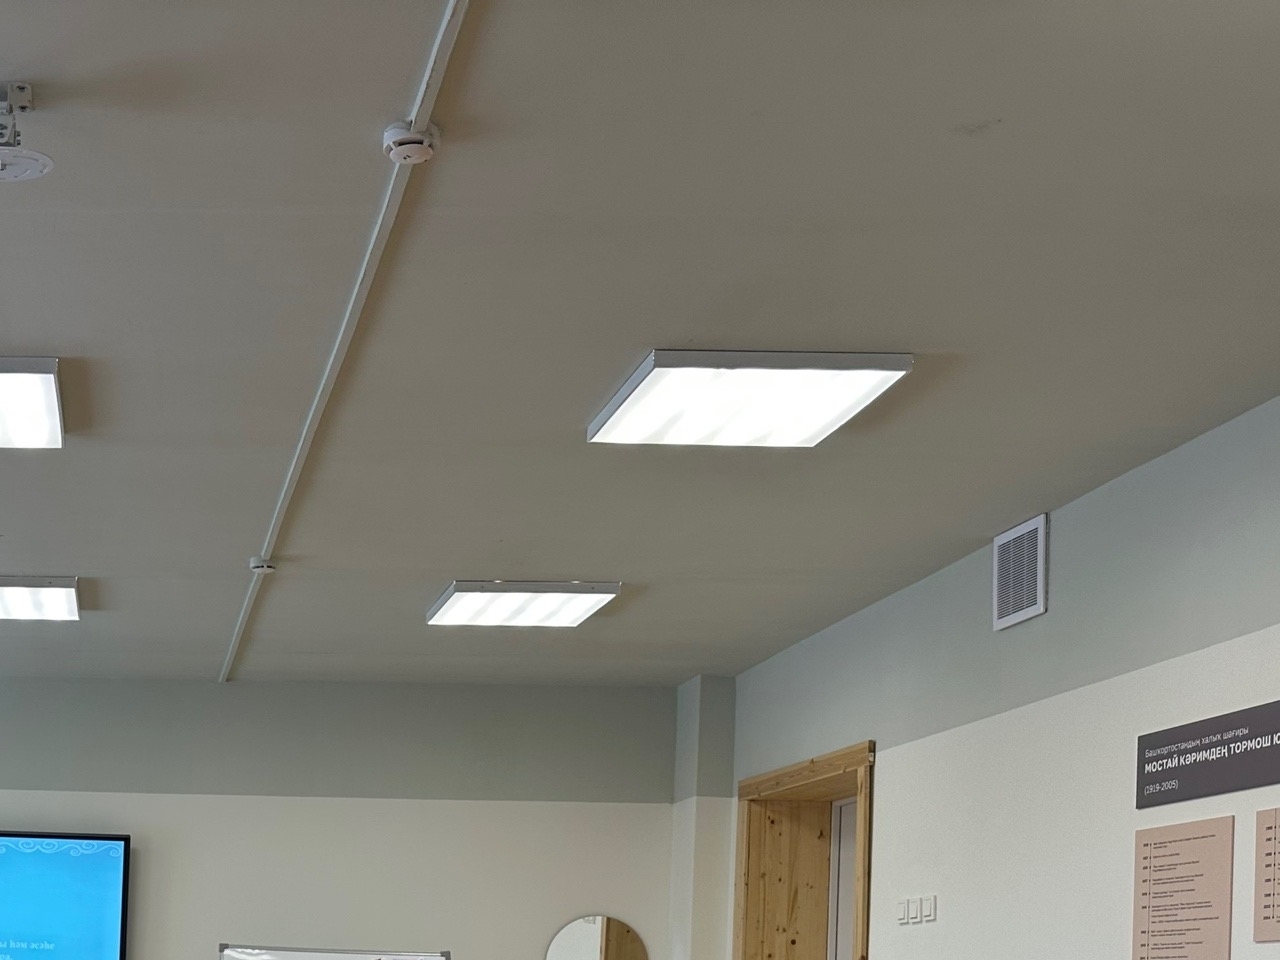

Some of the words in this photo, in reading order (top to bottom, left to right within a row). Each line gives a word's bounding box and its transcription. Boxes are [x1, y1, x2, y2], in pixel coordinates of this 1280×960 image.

[1144, 754, 1178, 774] МОСТАЙ
[1179, 745, 1228, 767] КӘРИМДЕҢ
[1230, 734, 1271, 755] ТОРМОШ
[1144, 780, 1179, 796] (1919-2005)
